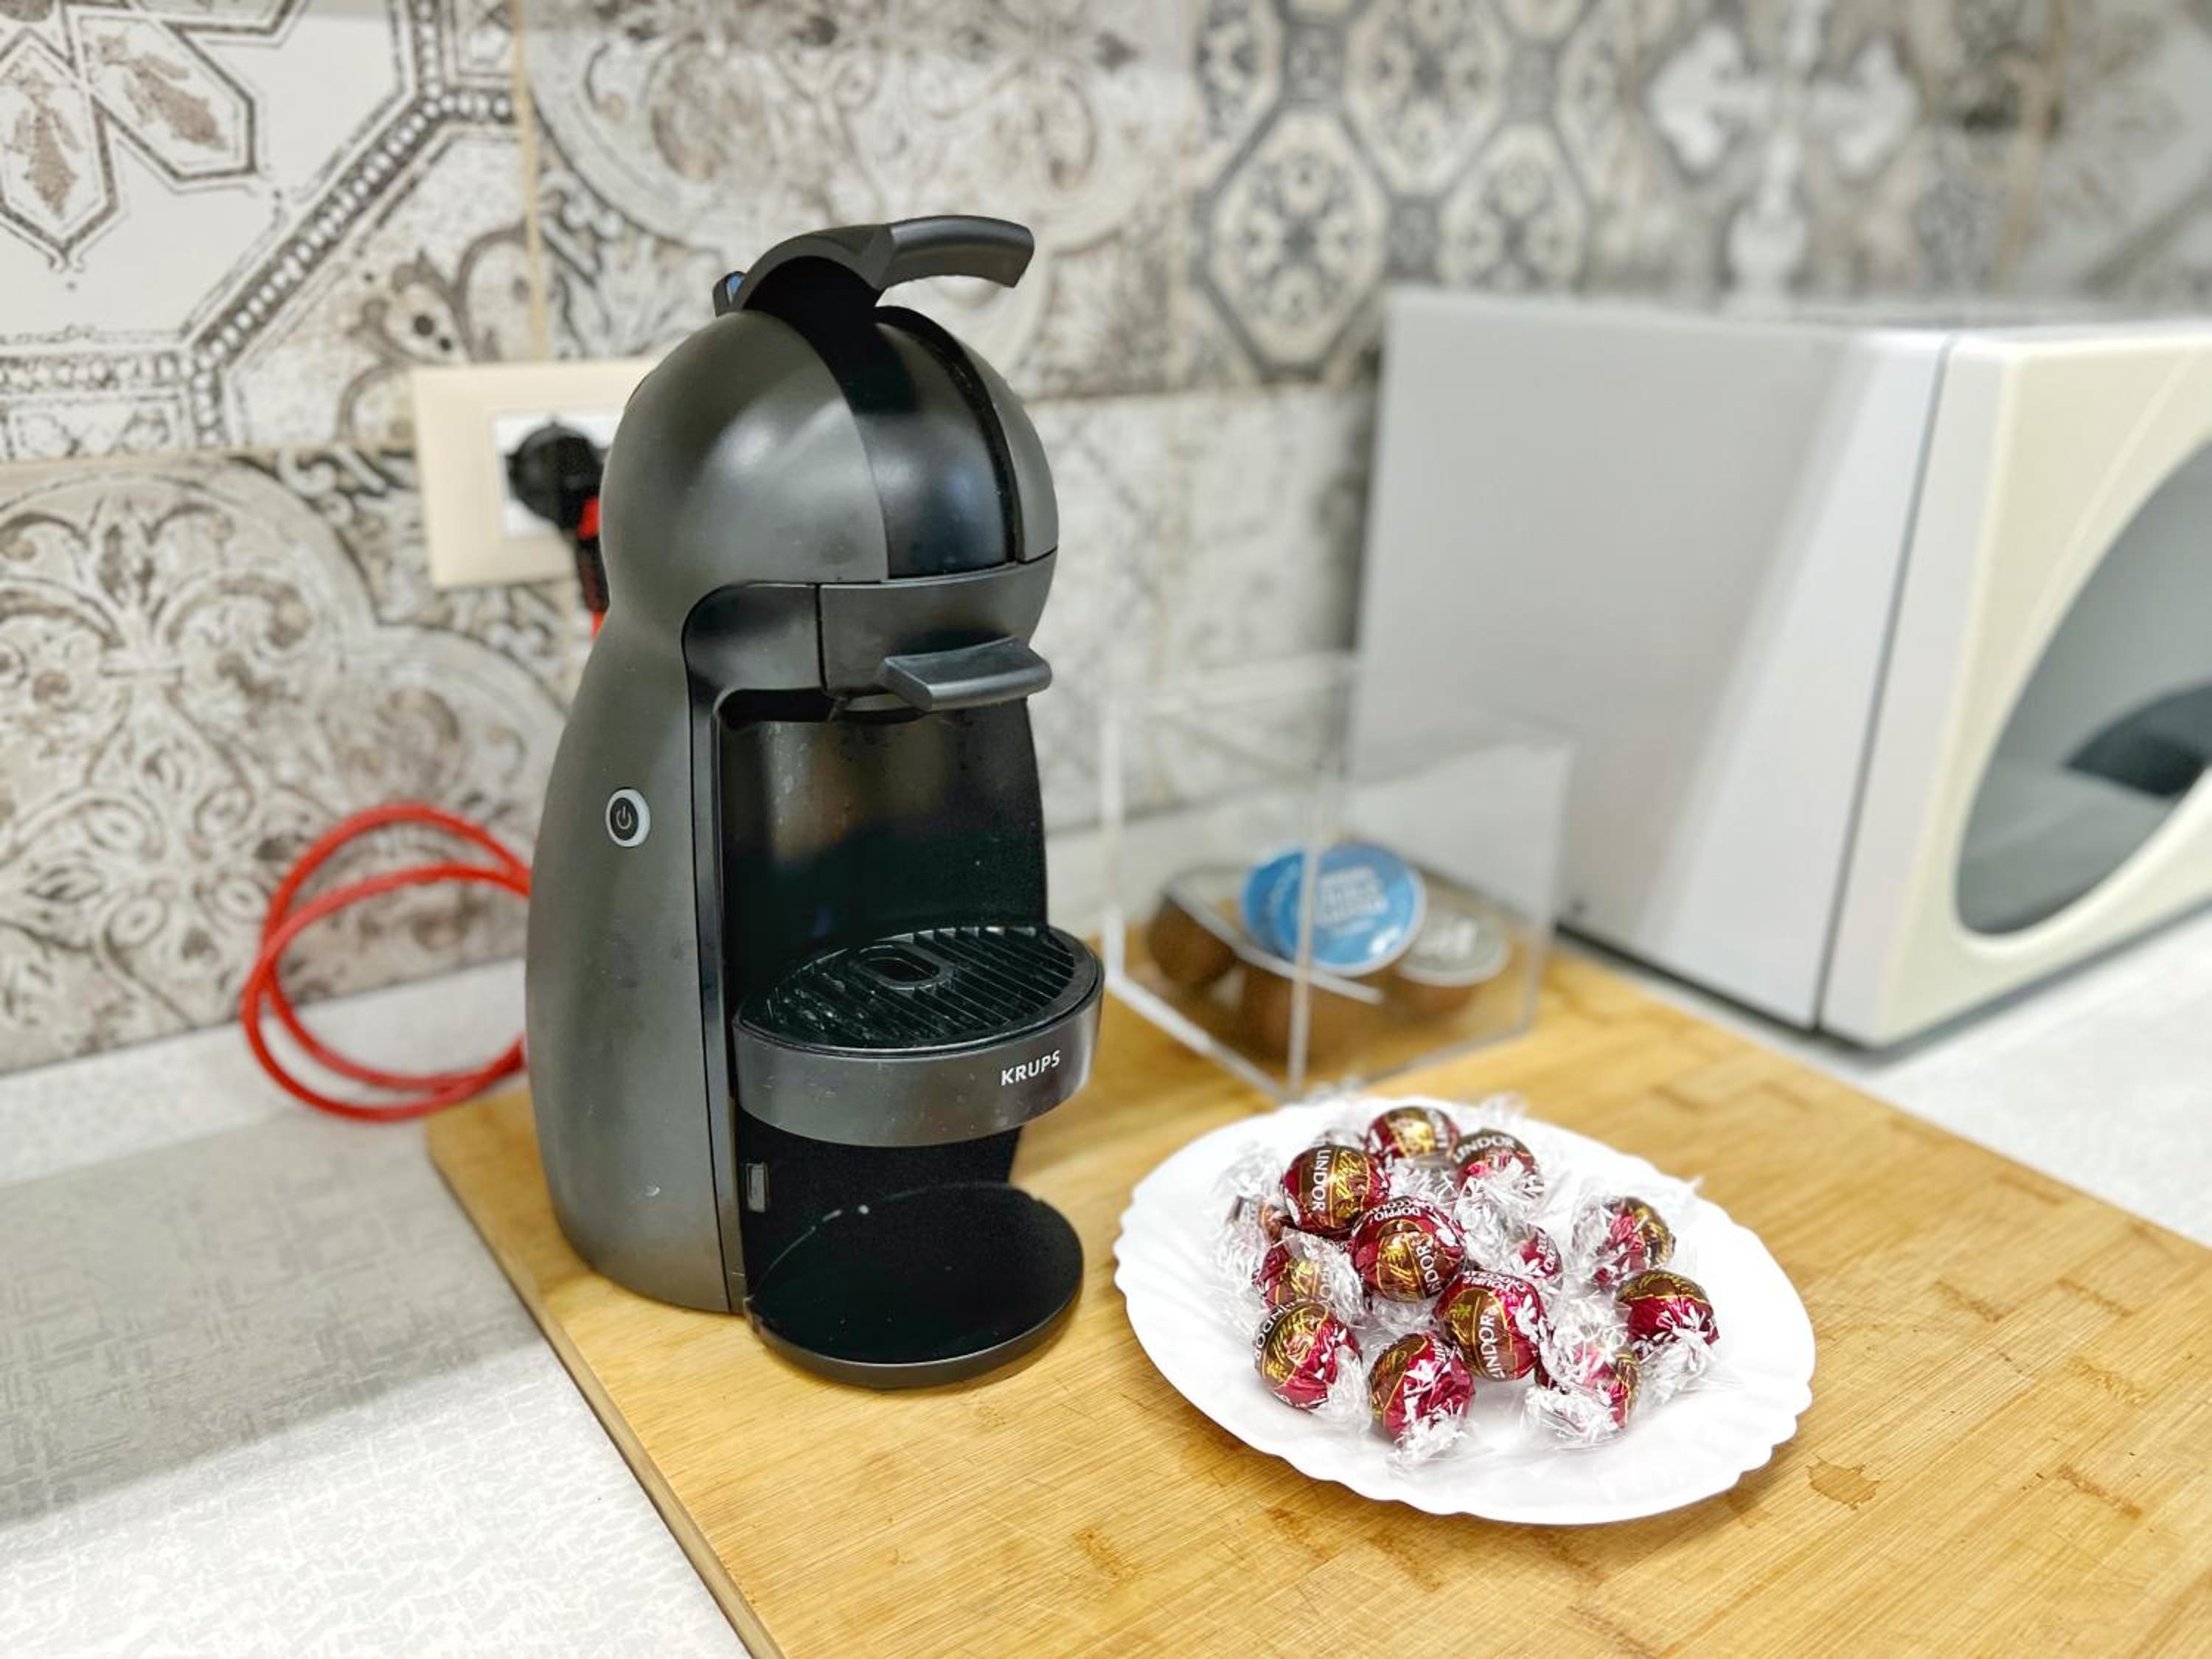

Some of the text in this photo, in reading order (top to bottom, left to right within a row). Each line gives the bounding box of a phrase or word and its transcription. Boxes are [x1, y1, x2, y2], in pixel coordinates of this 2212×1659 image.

[1001, 1049, 1060, 1086] KRUPS
[1311, 1149, 1332, 1211] LINDOR
[1478, 1315, 1506, 1378] LINDOR
